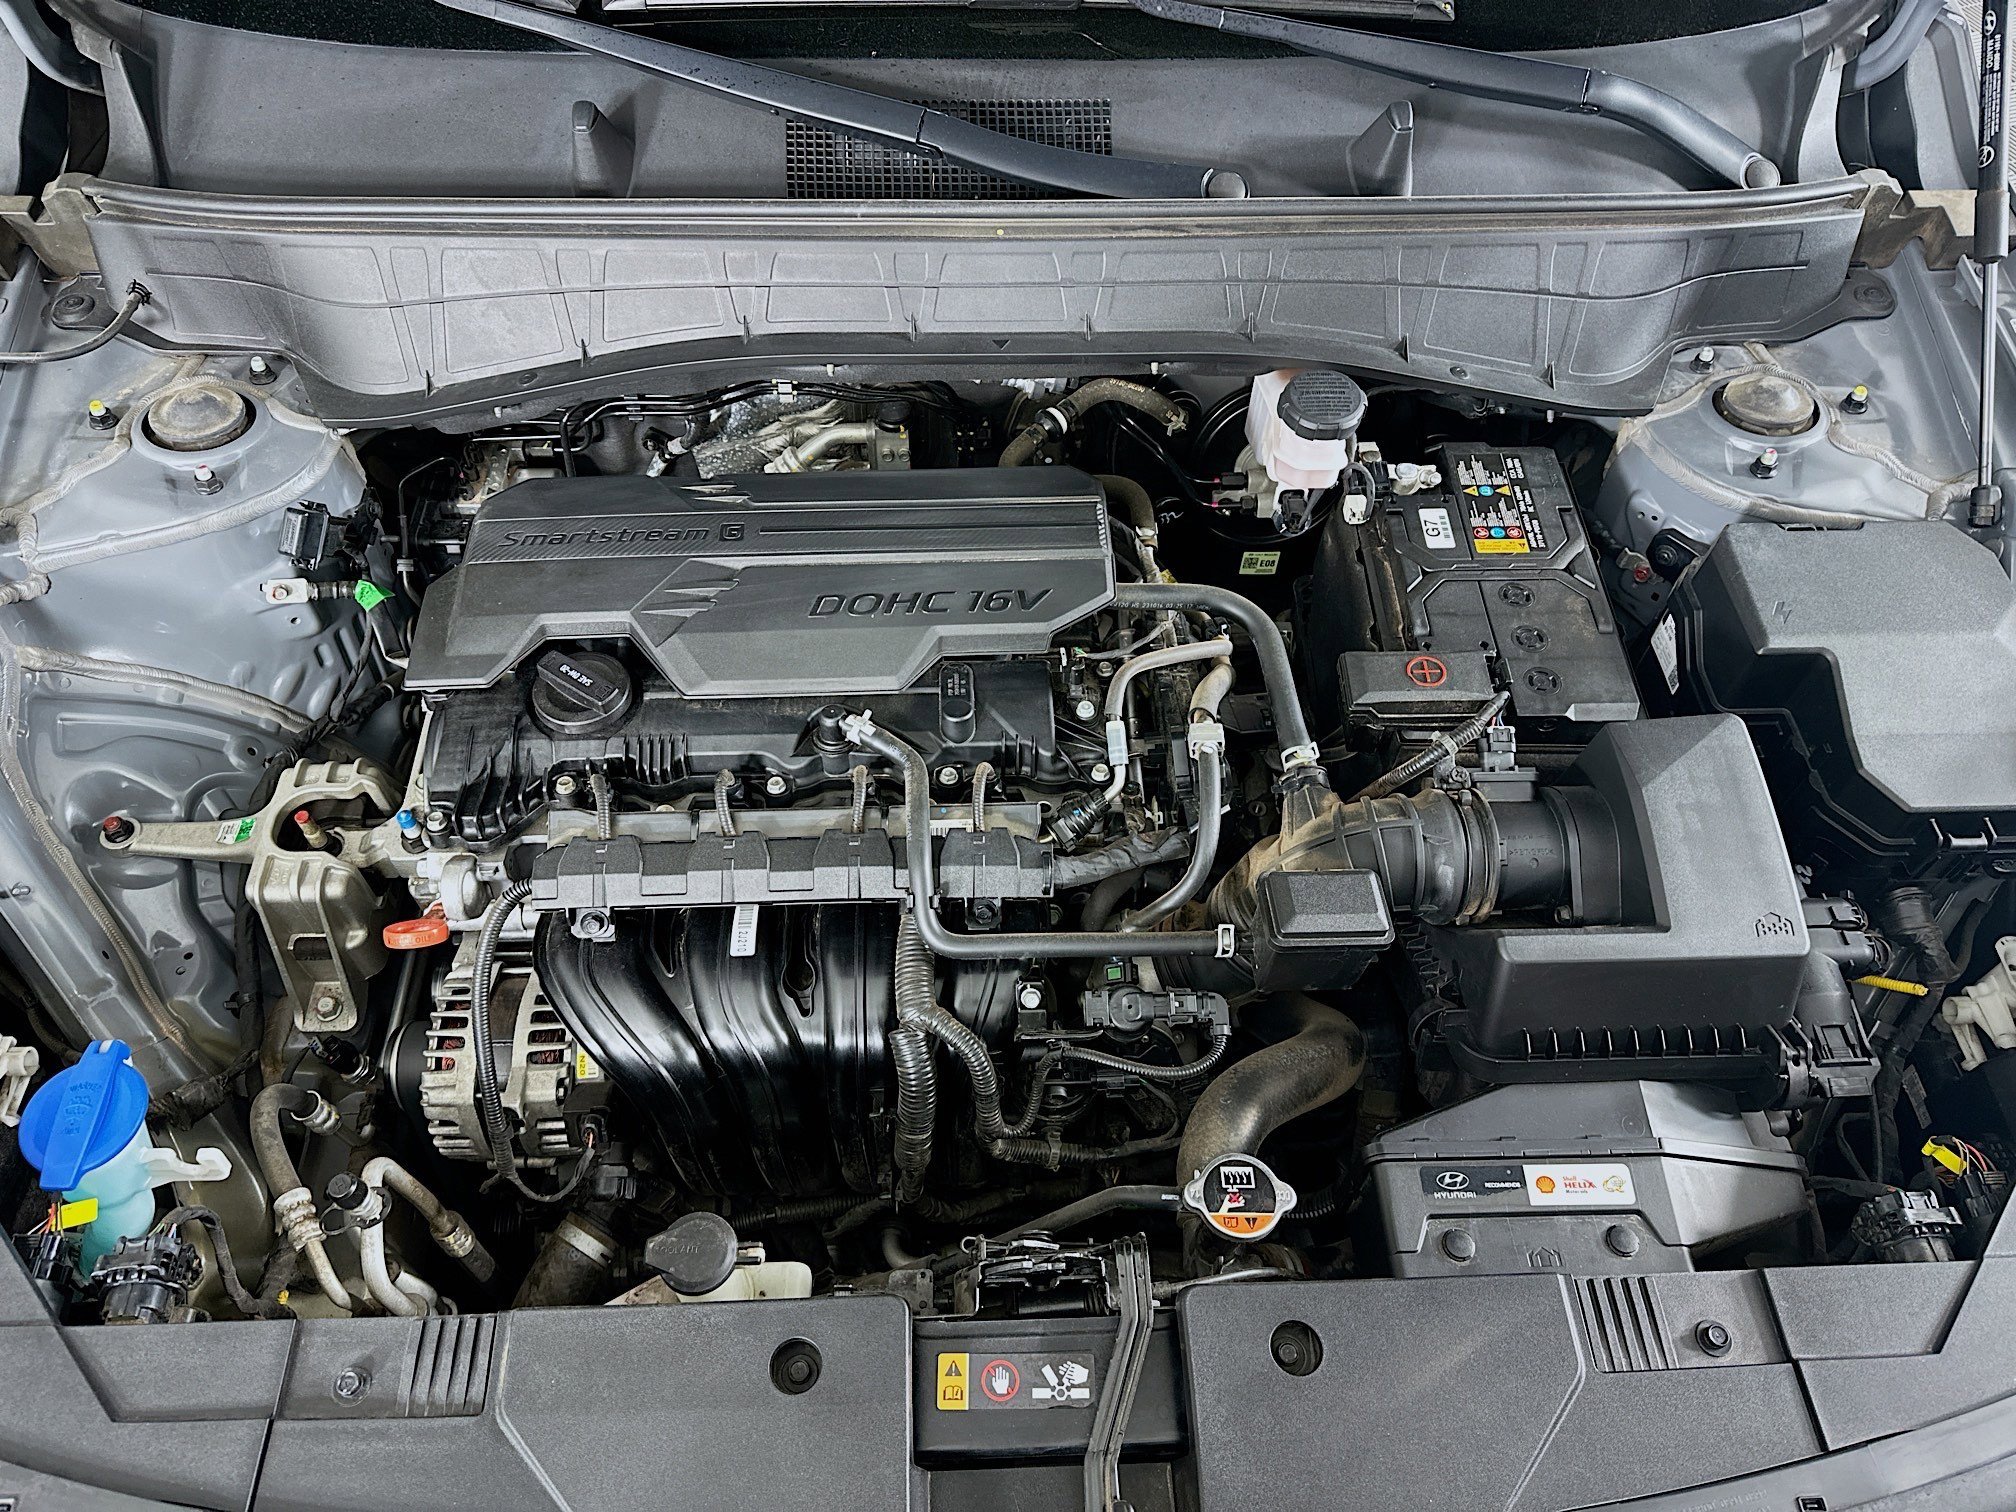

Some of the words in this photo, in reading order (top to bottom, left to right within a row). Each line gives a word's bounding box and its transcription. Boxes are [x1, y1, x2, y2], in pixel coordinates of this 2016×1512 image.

[1986, 38, 1994, 69] MANDO
[498, 526, 710, 547] Smartstream
[1424, 520, 1440, 537] G7
[1260, 559, 1276, 568] E08
[808, 591, 957, 618] DOHC
[967, 588, 1054, 613] 16V
[559, 664, 581, 680] 0W-20
[577, 675, 594, 687] SAE
[1564, 1180, 1597, 1189] HELIX
[1433, 1191, 1477, 1199] HYUNDAI
